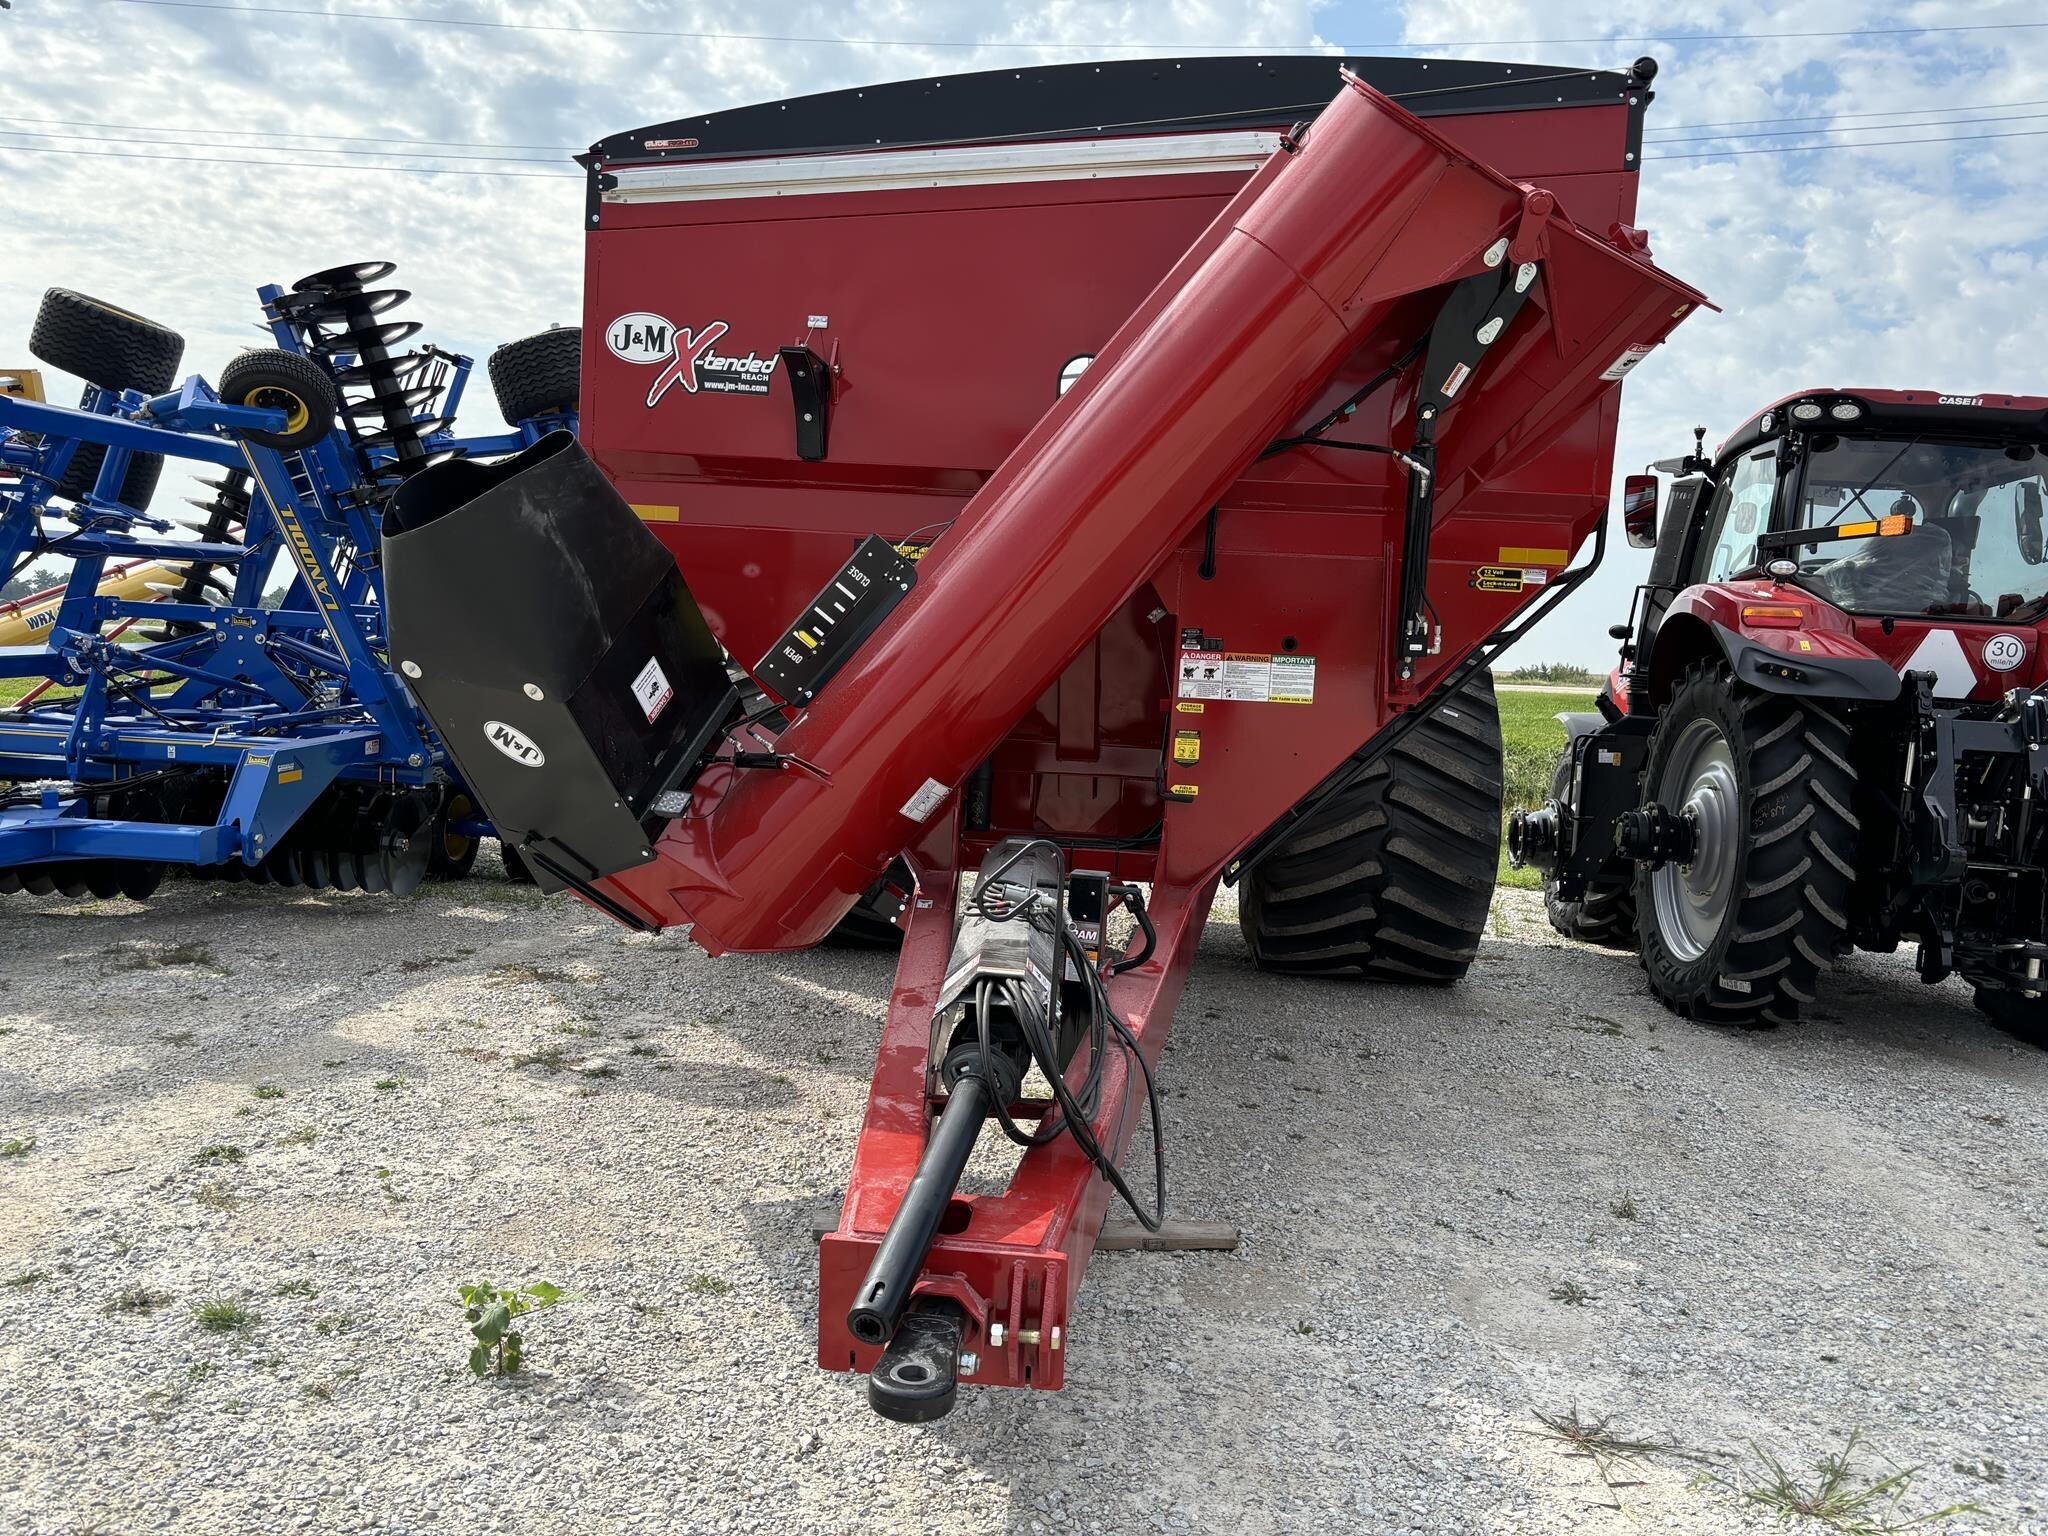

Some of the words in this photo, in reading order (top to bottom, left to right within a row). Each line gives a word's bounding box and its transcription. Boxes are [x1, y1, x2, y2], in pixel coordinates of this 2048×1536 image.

[613, 324, 668, 353] J&M
[741, 373, 769, 381] REACH
[704, 381, 768, 393] www.jm-inc.com
[1938, 396, 1971, 406] CASE
[280, 503, 339, 610] LANDOLL
[847, 565, 871, 587] CLOSE
[26, 609, 56, 630] WRX
[783, 645, 803, 664] OPEN
[1190, 652, 1221, 661] DANGER
[1991, 641, 2019, 658] 30
[1234, 655, 1269, 663] WARNING
[1272, 656, 1315, 665] IMPORTANT
[1990, 658, 2014, 666] mile/h
[492, 725, 539, 760] J&M
